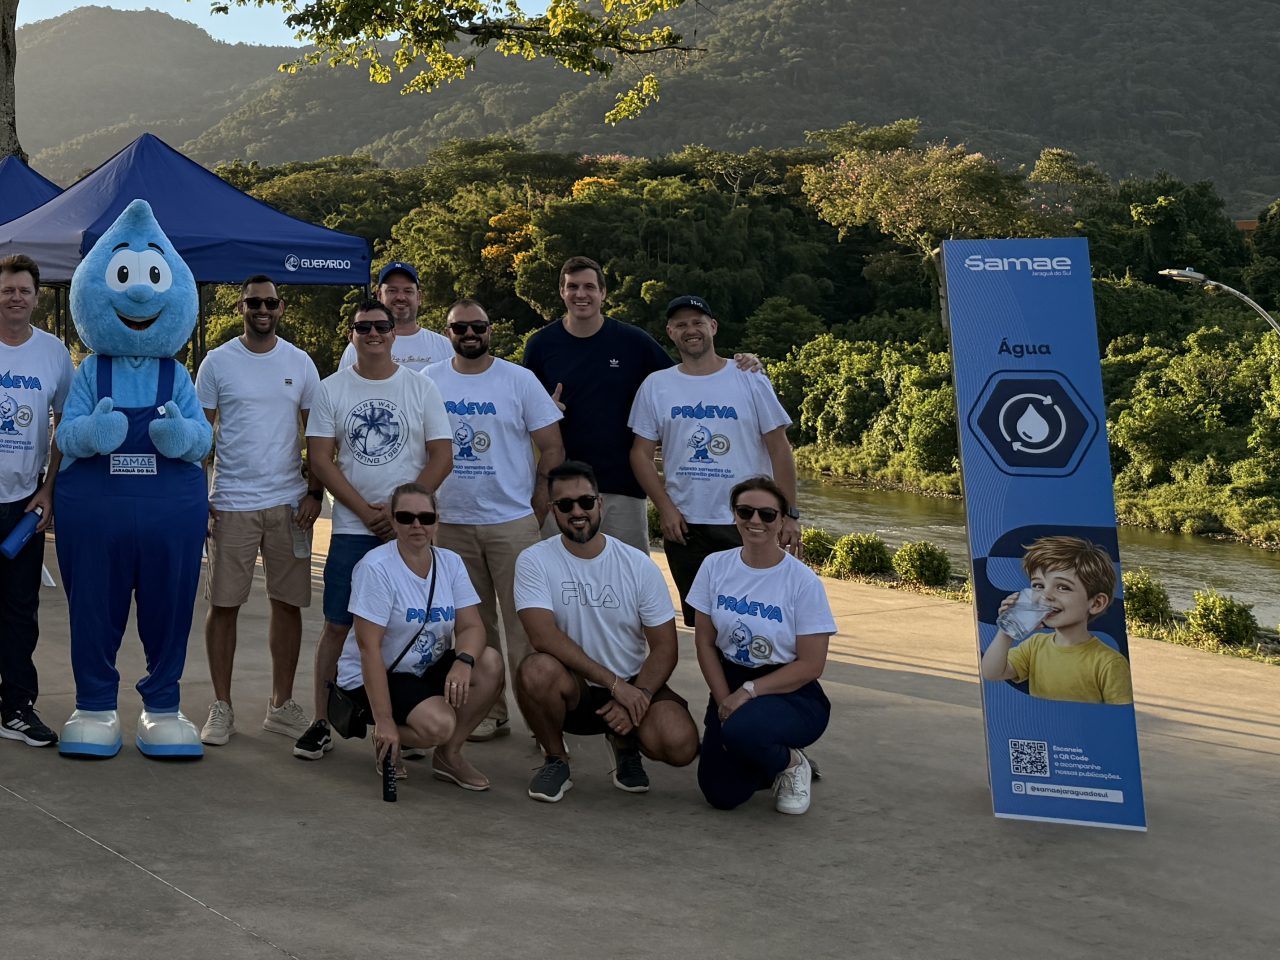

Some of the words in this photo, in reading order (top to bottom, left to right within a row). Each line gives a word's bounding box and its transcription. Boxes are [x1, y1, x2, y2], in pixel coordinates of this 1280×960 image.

[301, 258, 351, 269] GUEPARDO
[964, 255, 1072, 271] Samae
[998, 337, 1051, 358] Água
[444, 398, 496, 416] ROEVA
[671, 401, 738, 420] PROEVA
[19, 411, 30, 421] 20
[475, 436, 486, 446] 20
[712, 440, 725, 450] 20
[112, 456, 154, 466] SAMAE
[561, 582, 620, 608] FILA
[717, 594, 783, 623] PROEVA
[753, 642, 768, 654] 20
[1060, 762, 1102, 770] acompanhe
